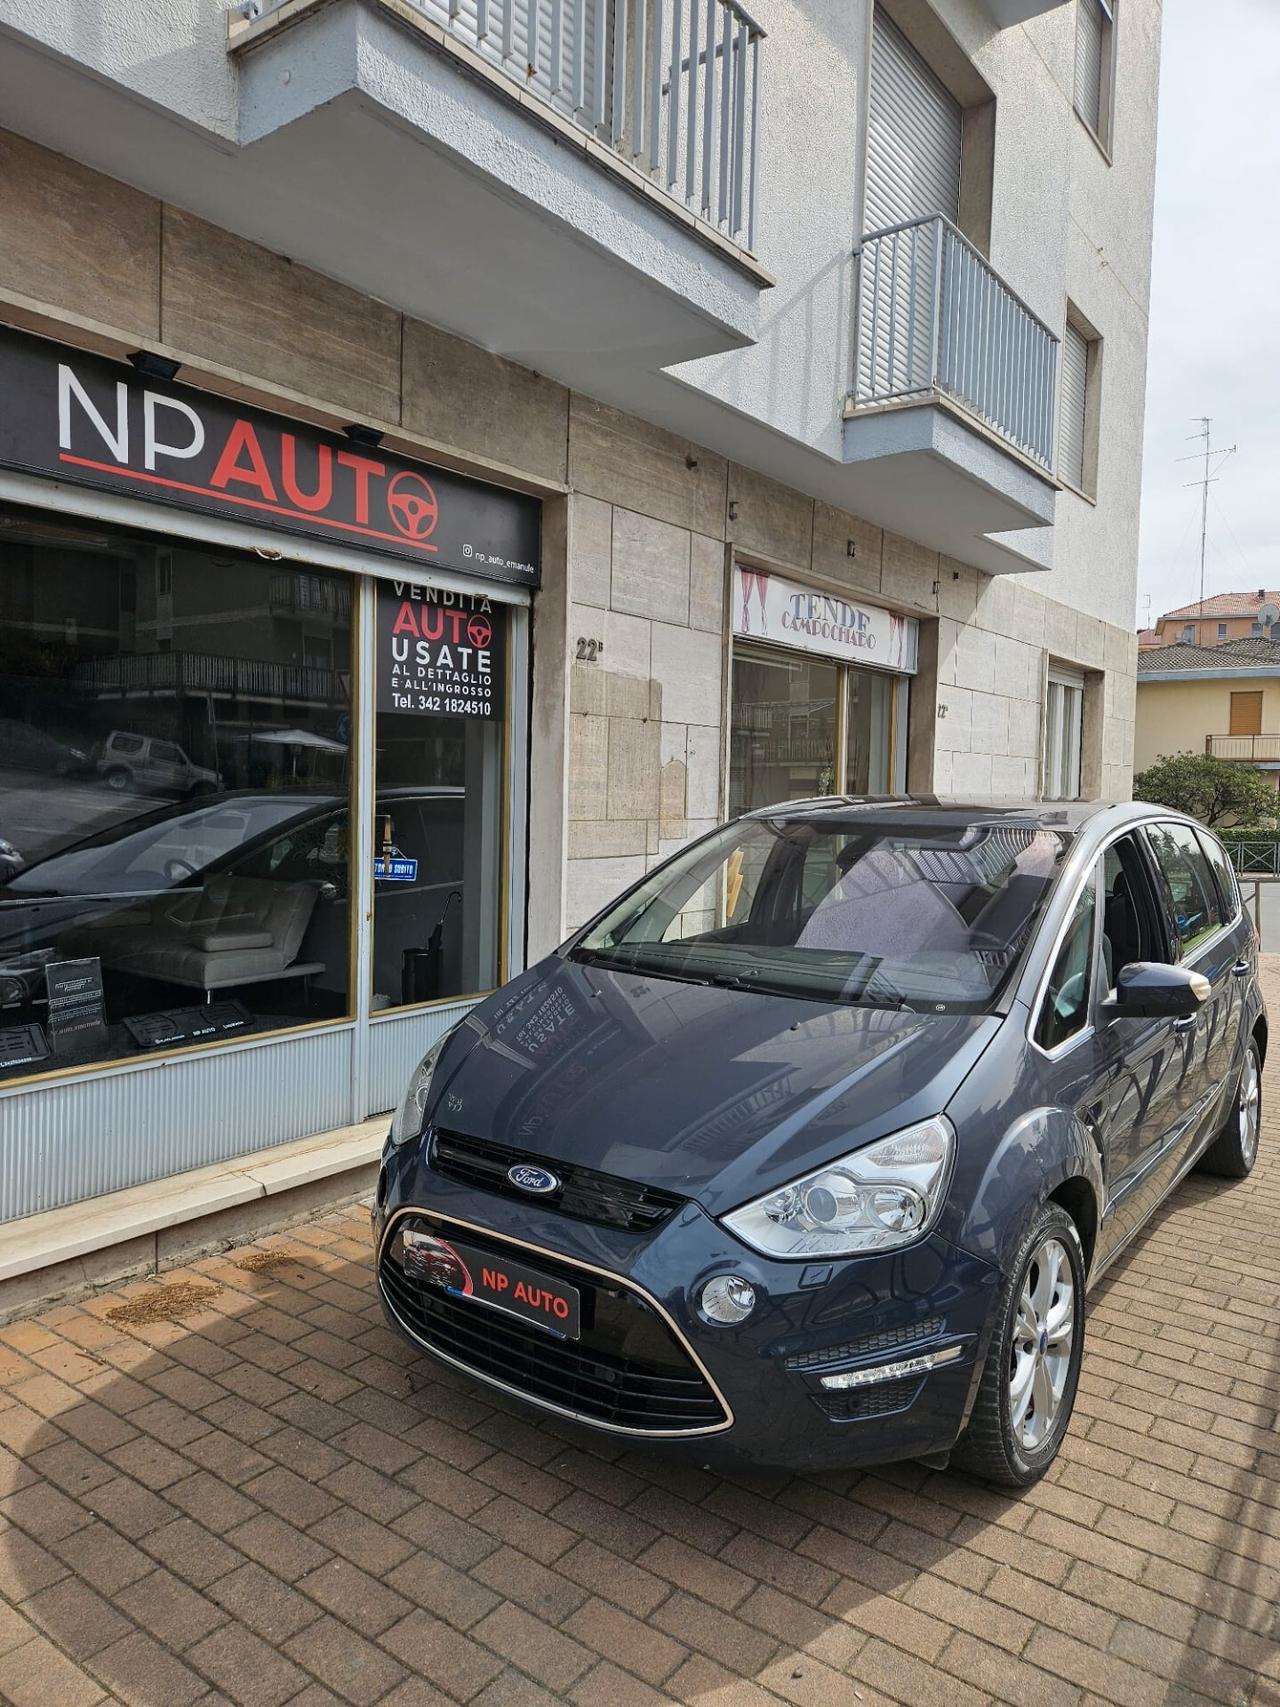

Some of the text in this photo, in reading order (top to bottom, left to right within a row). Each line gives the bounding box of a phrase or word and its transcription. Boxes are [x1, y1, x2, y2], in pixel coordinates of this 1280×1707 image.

[58, 363, 206, 471] NP
[392, 601, 492, 649] AUTO
[790, 593, 870, 631] TENDE
[392, 637, 491, 673] USATE
[391, 678, 492, 698] E ALL'INGROSSO
[392, 664, 492, 686] AL DETTAGLIO
[392, 693, 492, 716] Tel. 342 1824510
[515, 1168, 545, 1187] Ford
[482, 1267, 569, 1319] NP AUTO
